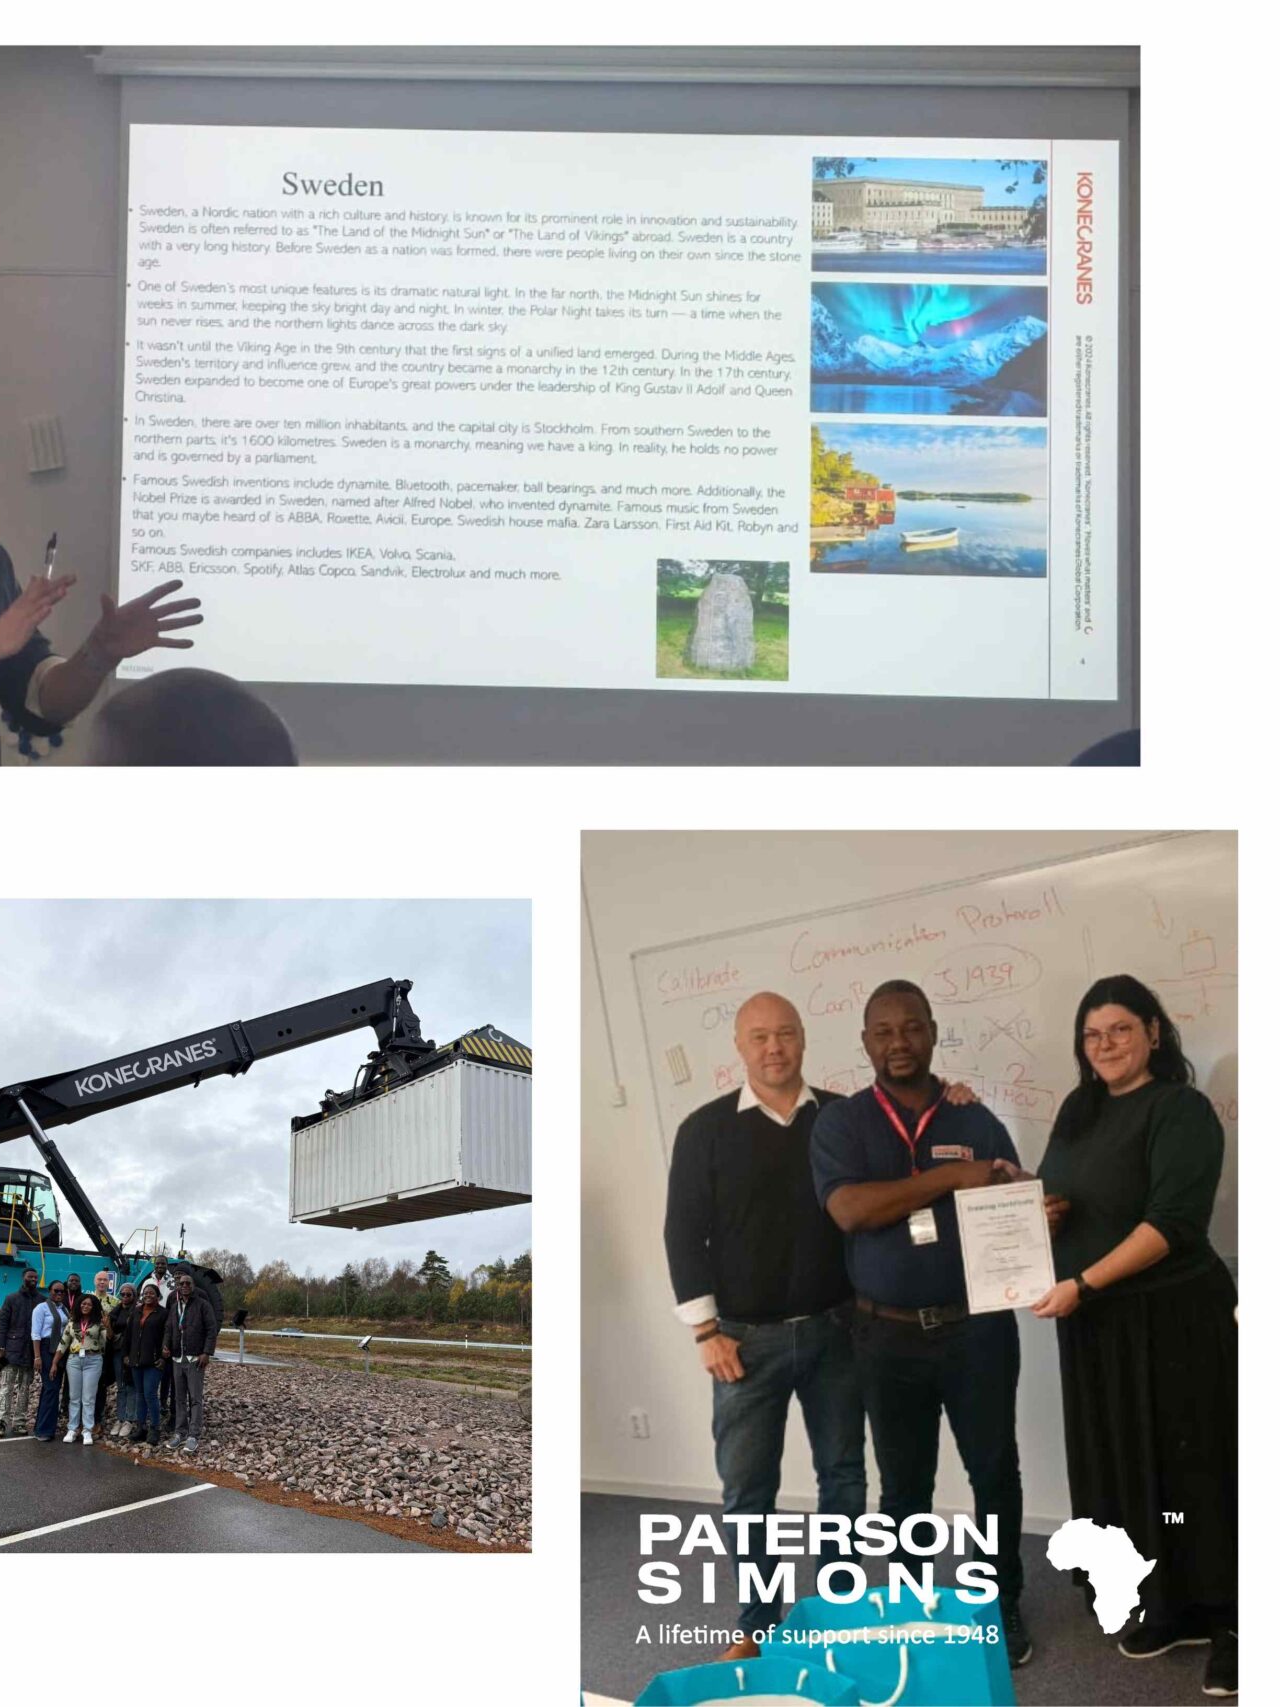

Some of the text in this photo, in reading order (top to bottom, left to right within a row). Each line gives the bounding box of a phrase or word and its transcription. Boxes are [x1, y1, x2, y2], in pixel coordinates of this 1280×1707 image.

[282, 172, 384, 197] Sweden
[201, 206, 239, 217] Nordic
[241, 208, 278, 218] nation
[280, 208, 305, 219] with
[317, 208, 340, 219] rich
[342, 209, 381, 220] culture
[383, 210, 406, 221] and
[464, 212, 503, 222] known
[505, 211, 520, 222] for
[523, 212, 538, 223] its
[540, 213, 599, 225] prominent
[600, 214, 623, 224] role
[625, 214, 637, 224] in
[639, 215, 697, 225] innovation
[700, 216, 723, 226] and
[139, 221, 185, 233] Sweden
[200, 222, 230, 234] often
[232, 223, 278, 235] referred
[280, 225, 293, 236] to
[295, 227, 309, 236] as
[341, 225, 371, 237] Land
[372, 225, 385, 237] of
[388, 227, 408, 237] the
[410, 227, 460, 241] Midnight
[492, 230, 505, 239] or
[536, 229, 566, 240] Land
[568, 229, 580, 240] of
[676, 231, 724, 243] Sweden
[749, 234, 793, 247] country
[1076, 172, 1093, 305] KONECRANES
[137, 280, 162, 292] One
[163, 280, 177, 292] of
[179, 281, 236, 293] Sweden's
[238, 284, 267, 293] most
[269, 284, 309, 295] unique
[311, 284, 358, 295] features
[372, 285, 387, 296] its
[389, 286, 439, 296] dramatic
[441, 287, 481, 297] natural
[514, 287, 526, 298] In
[528, 288, 548, 298] the
[550, 287, 565, 299] far
[605, 289, 625, 300] the
[627, 289, 677, 303] Midnight
[679, 289, 703, 301] Sun
[705, 290, 743, 302] shines
[745, 290, 760, 302] for
[136, 317, 158, 325] sun
[160, 317, 192, 326] never
[226, 317, 250, 327] and
[252, 317, 271, 328] the
[273, 317, 324, 329] northern
[325, 318, 357, 332] lights
[359, 319, 395, 330] dance
[396, 322, 435, 331] across
[437, 320, 457, 331] the
[458, 320, 484, 331] dark
[133, 449, 155, 461] and
[157, 449, 168, 461] is
[169, 451, 224, 464] governed
[226, 451, 241, 465] by
[131, 528, 146, 537] so
[131, 542, 177, 555] Famous
[179, 544, 228, 556] Swedish
[230, 547, 292, 558] companies
[295, 546, 343, 558] includes
[287, 563, 315, 575] Atlas
[410, 566, 466, 578] Electrolux
[469, 568, 491, 578] and
[494, 569, 526, 579] much
[790, 922, 946, 974] Communication
[657, 959, 741, 994] Calibrate
